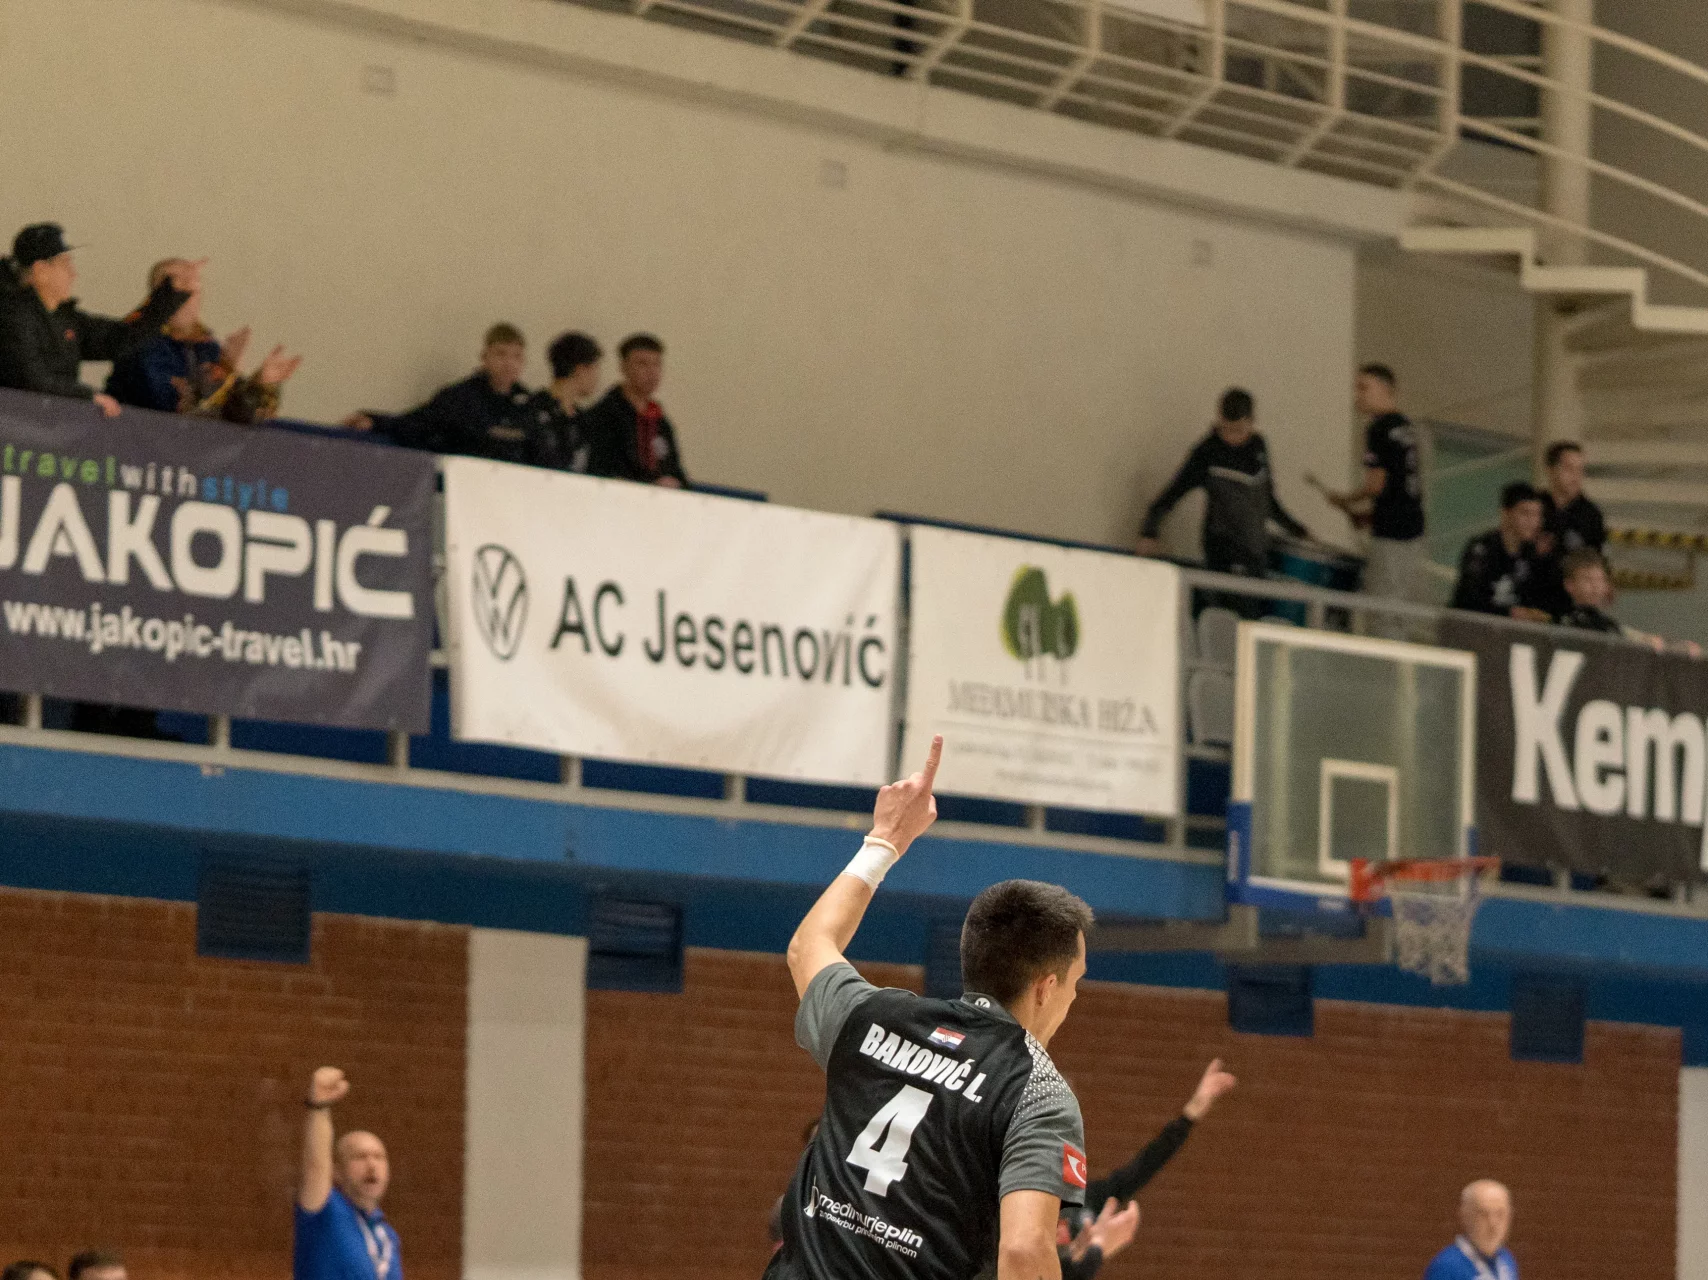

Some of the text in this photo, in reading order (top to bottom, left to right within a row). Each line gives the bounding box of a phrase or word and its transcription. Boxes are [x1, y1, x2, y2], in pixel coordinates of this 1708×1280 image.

[0, 475, 415, 619] JAKOPIĆ
[4, 600, 362, 671] www.jakopic-travel.hr
[549, 574, 888, 689] AC Jesenović
[1509, 642, 1708, 872] Kem
[859, 1022, 987, 1103] BAKOVIĆ L.
[845, 1083, 934, 1197] 4
[885, 1240, 917, 1259] plinom
